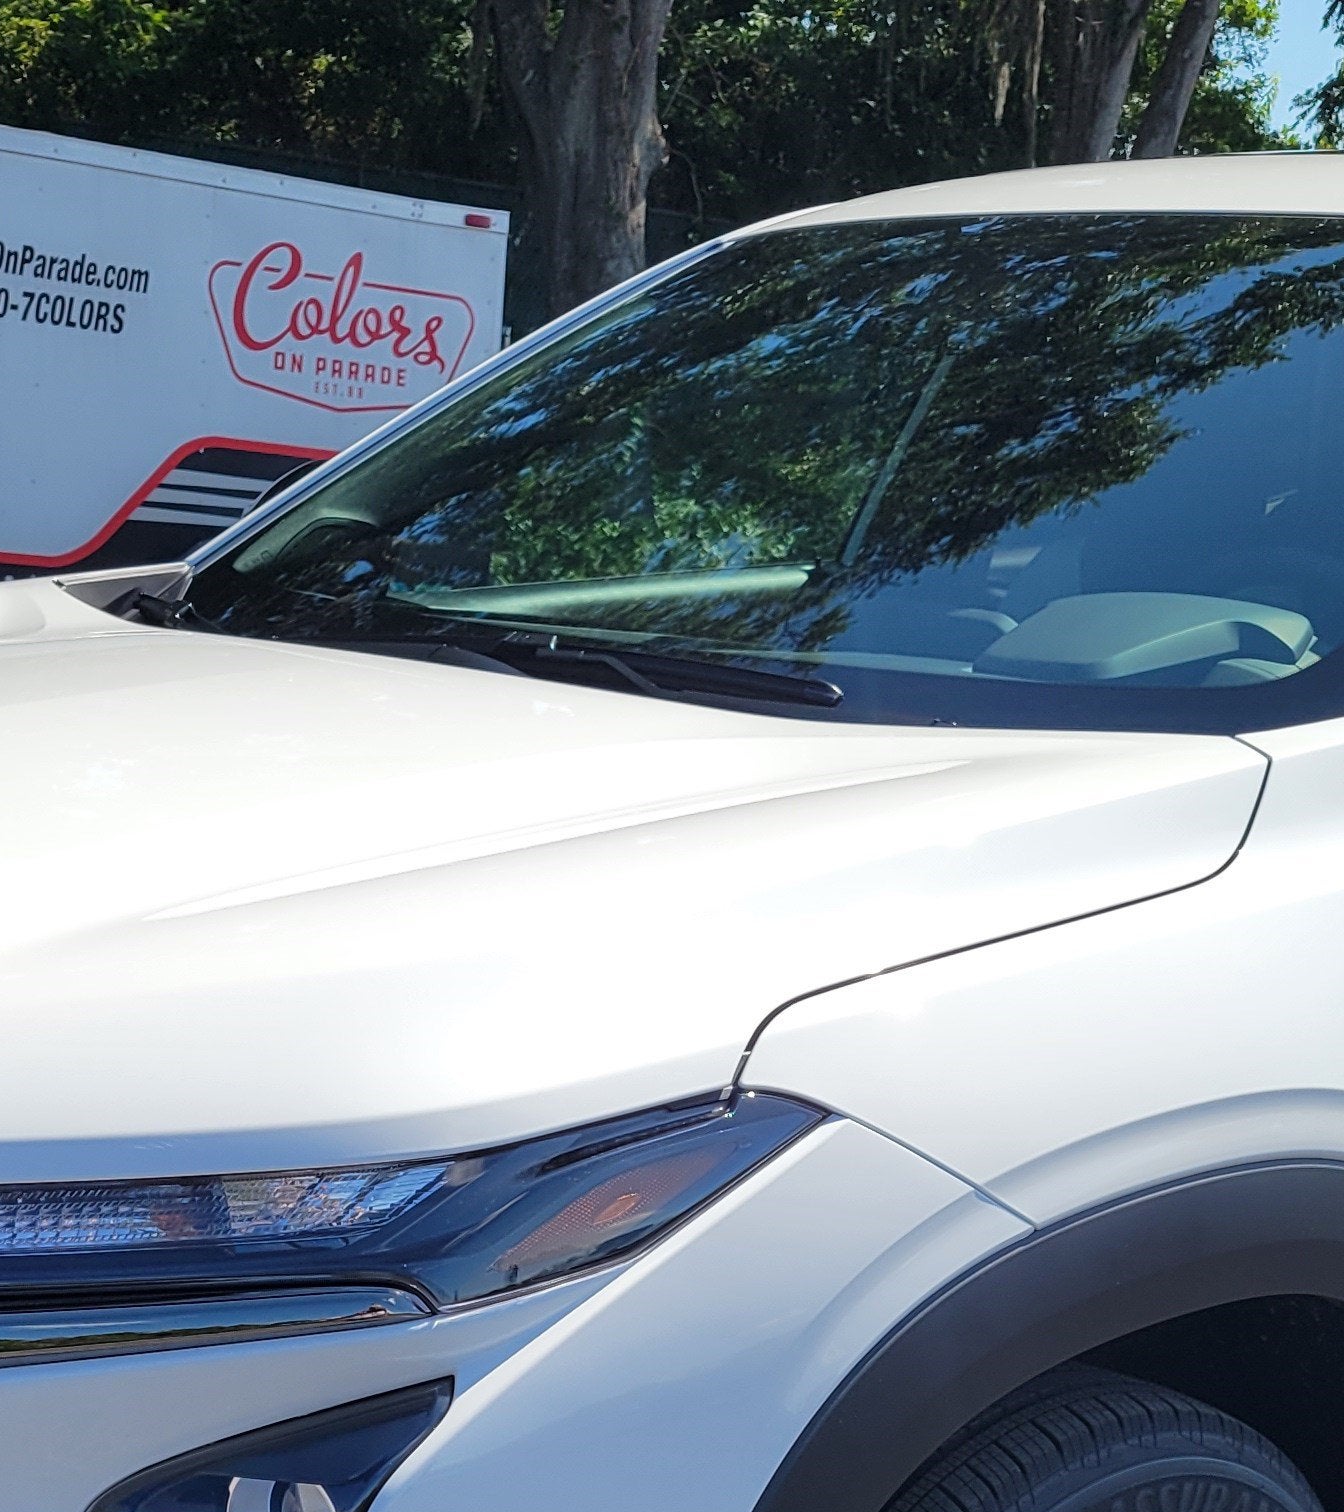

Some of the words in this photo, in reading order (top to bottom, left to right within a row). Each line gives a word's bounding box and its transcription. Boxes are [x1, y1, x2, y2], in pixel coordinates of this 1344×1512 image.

[233, 241, 444, 374] Colors
[273, 351, 304, 373] ON
[315, 356, 406, 387] PARADE
